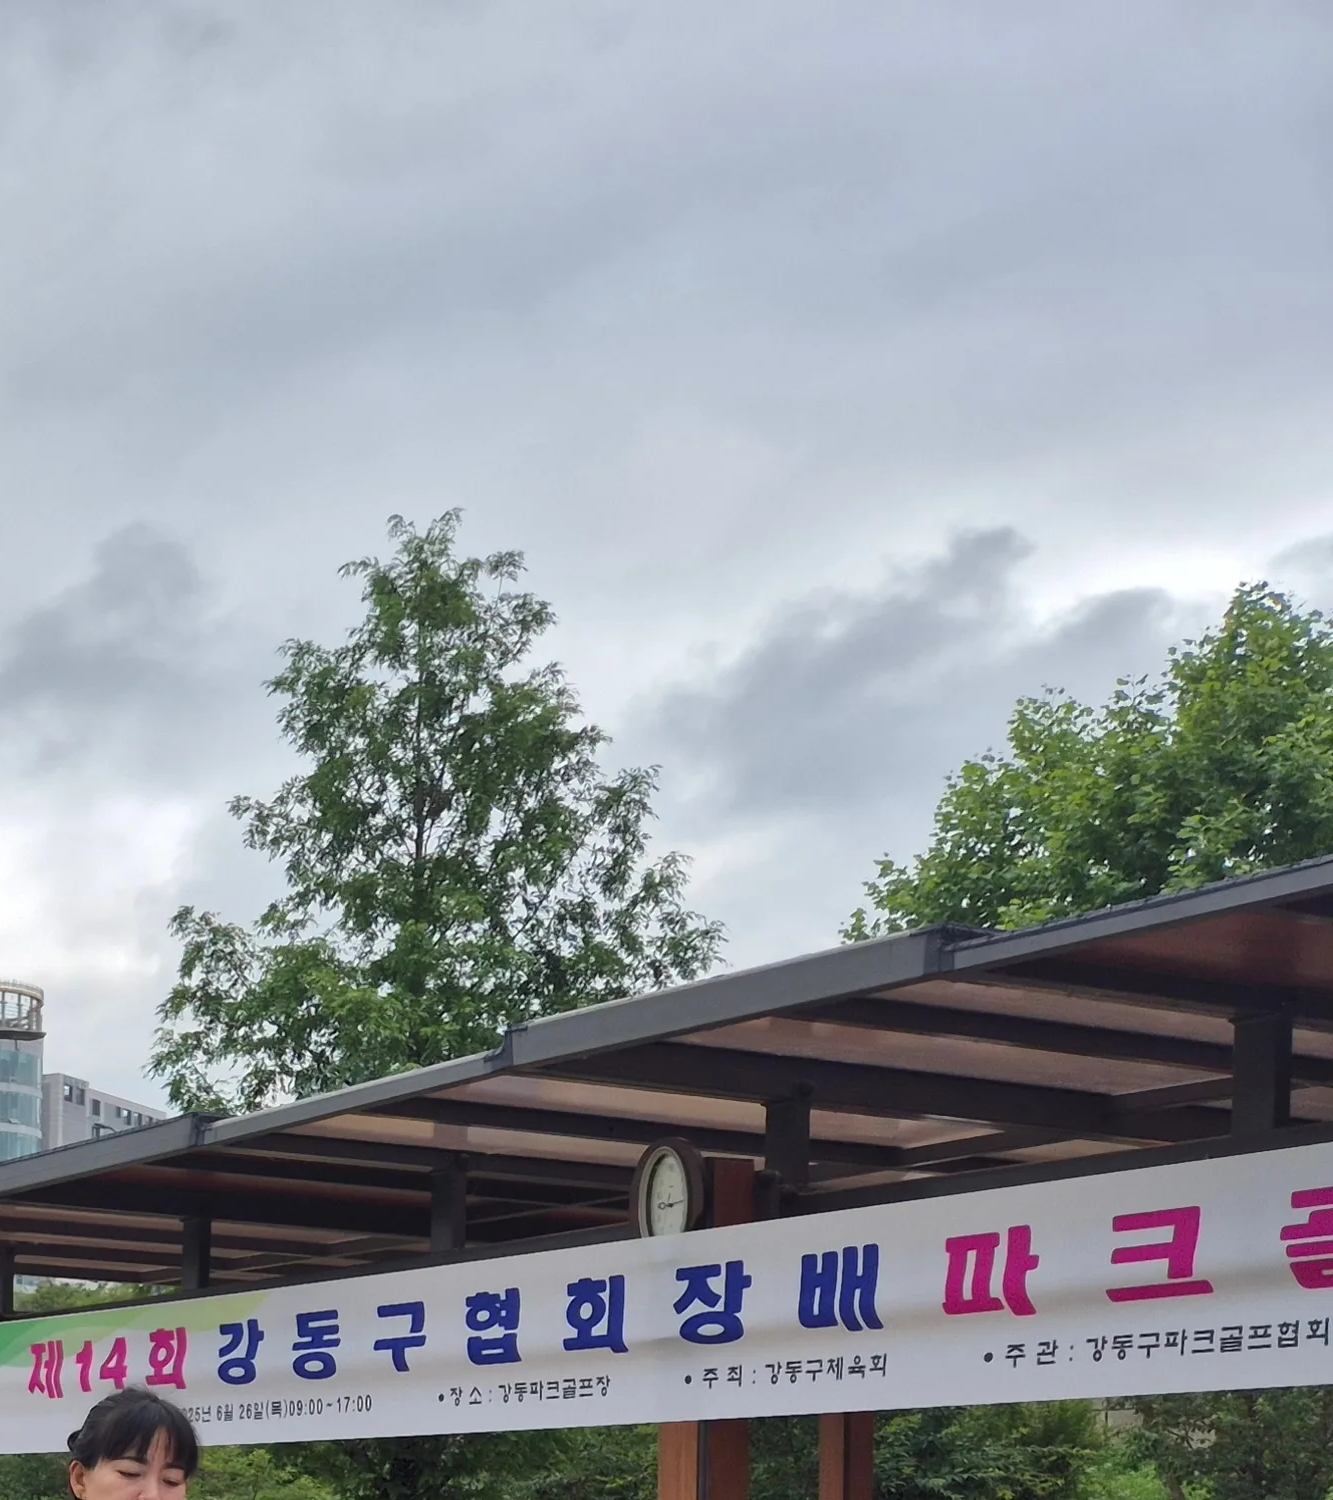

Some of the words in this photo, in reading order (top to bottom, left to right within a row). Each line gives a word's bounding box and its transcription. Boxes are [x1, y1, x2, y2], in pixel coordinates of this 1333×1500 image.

[1086, 1317, 1330, 1362] 강동구파크골프협회
[27, 1326, 188, 1399] 제14회
[765, 1353, 887, 1385] 강동구체육회
[498, 1375, 611, 1403] 강동파크골프장
[217, 1403, 234, 1422] 6월
